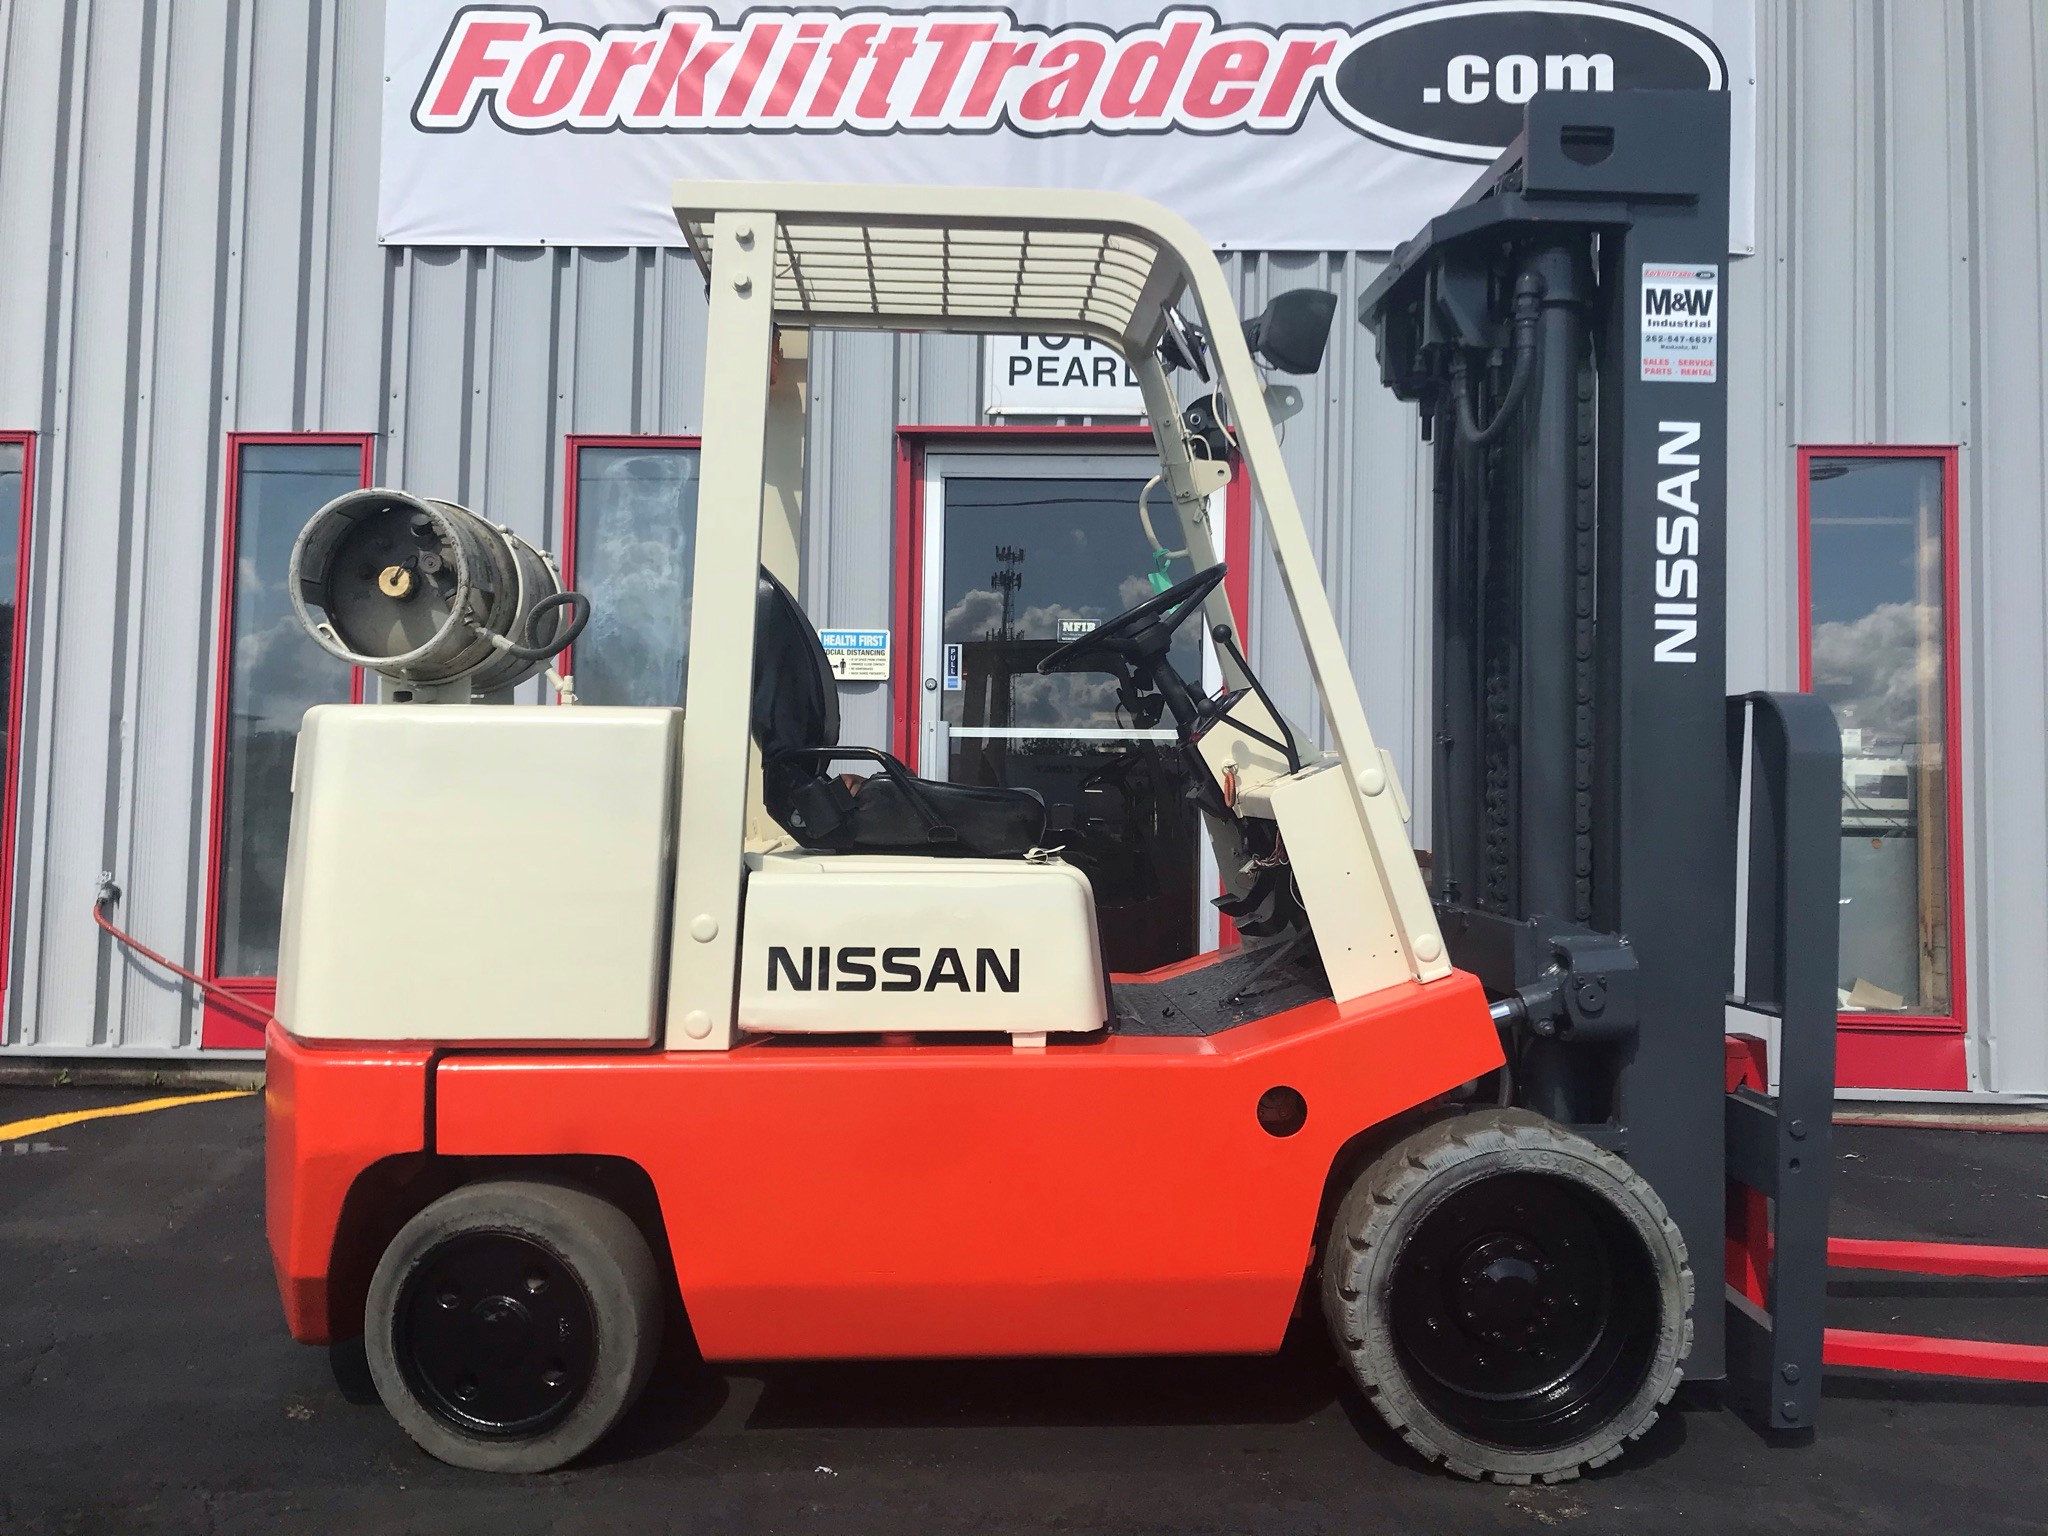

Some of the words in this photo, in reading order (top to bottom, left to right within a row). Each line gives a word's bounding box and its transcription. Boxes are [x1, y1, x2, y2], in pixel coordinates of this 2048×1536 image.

[420, 13, 1340, 126] ForkliftTrader
[1645, 288, 1714, 316] M&W
[1648, 318, 1711, 328] Industrial
[1643, 358, 1669, 366] SALES
[1677, 359, 1714, 367] SERVICE
[1644, 367, 1672, 375] PARTS
[1680, 368, 1712, 376] RENTAL
[1653, 420, 1701, 663] NISSAN
[1062, 621, 1096, 632] NFIB
[823, 634, 856, 646] HEALTH
[858, 635, 884, 646] FIRST
[767, 946, 1020, 993] NISSAN
